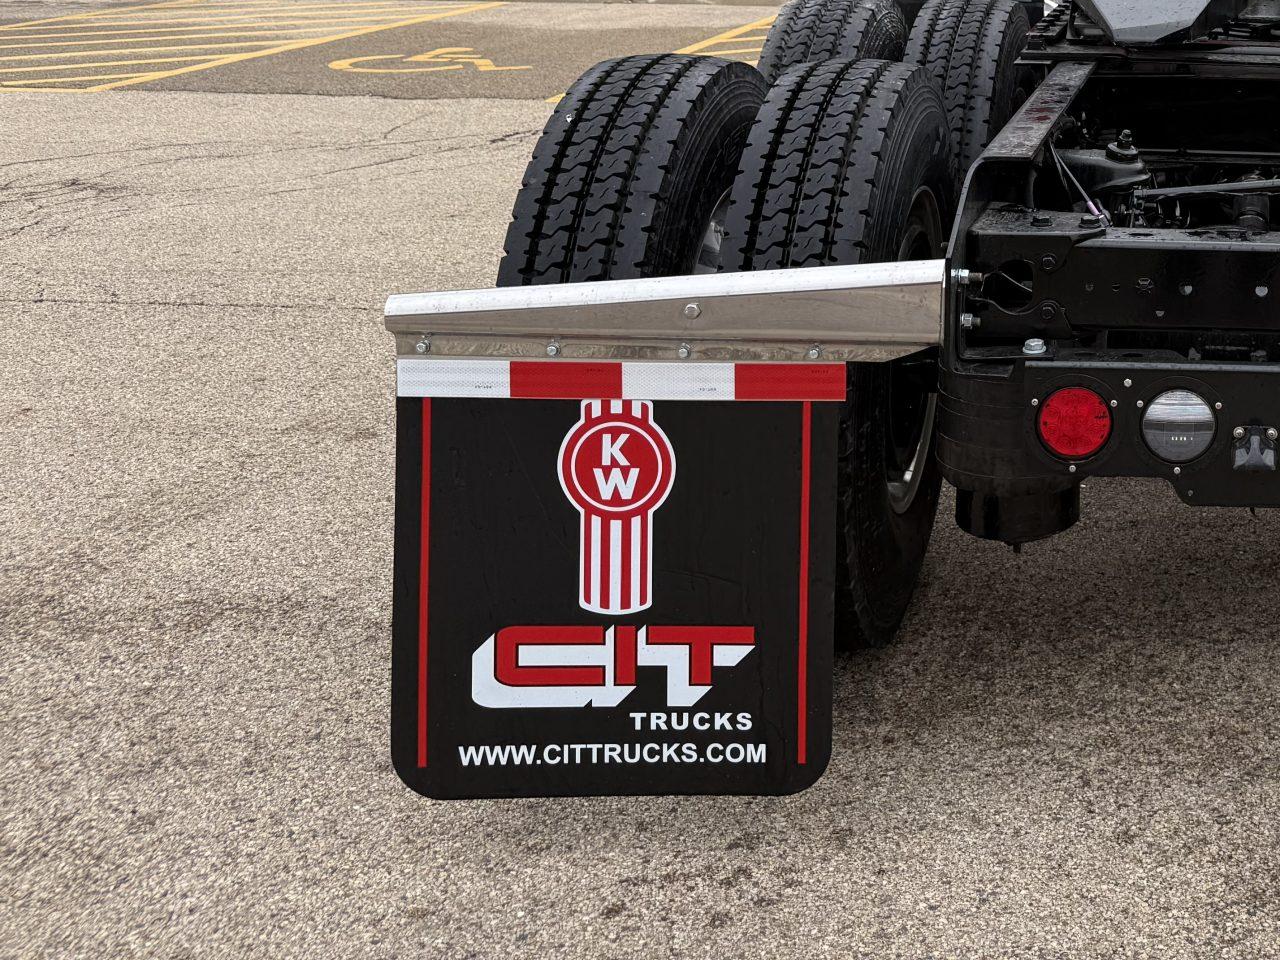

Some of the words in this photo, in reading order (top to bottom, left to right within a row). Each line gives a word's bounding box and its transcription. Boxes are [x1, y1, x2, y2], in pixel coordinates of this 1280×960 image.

[472, 624, 755, 708] CIT
[629, 712, 753, 731] TRUCKS
[458, 742, 767, 767] WWW.CITTRUCKS.COM
